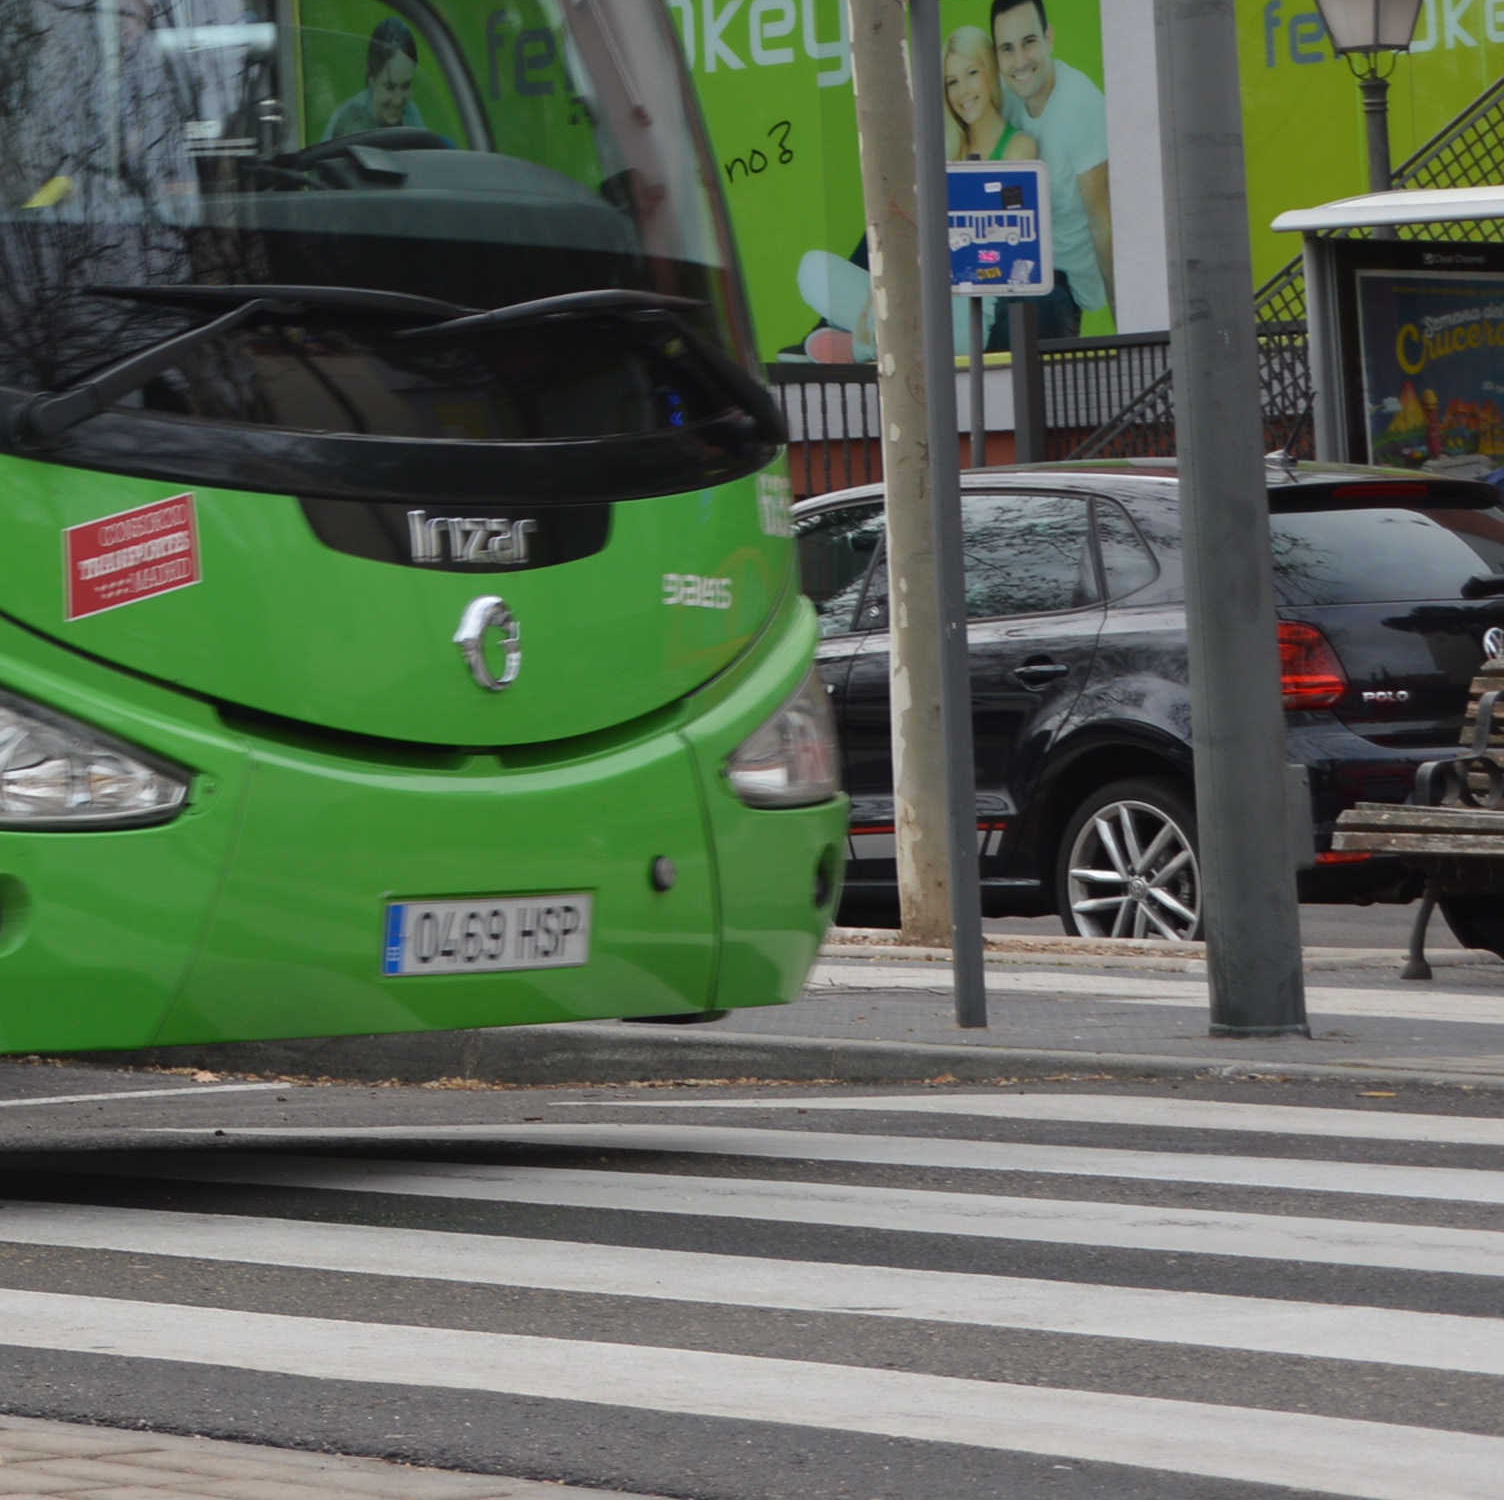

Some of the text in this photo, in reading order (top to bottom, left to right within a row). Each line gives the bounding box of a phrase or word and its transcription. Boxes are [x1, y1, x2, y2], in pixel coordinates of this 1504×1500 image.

[1361, 689, 1410, 703] POLO
[412, 909, 507, 965] 0469
[513, 904, 581, 960] HSP
